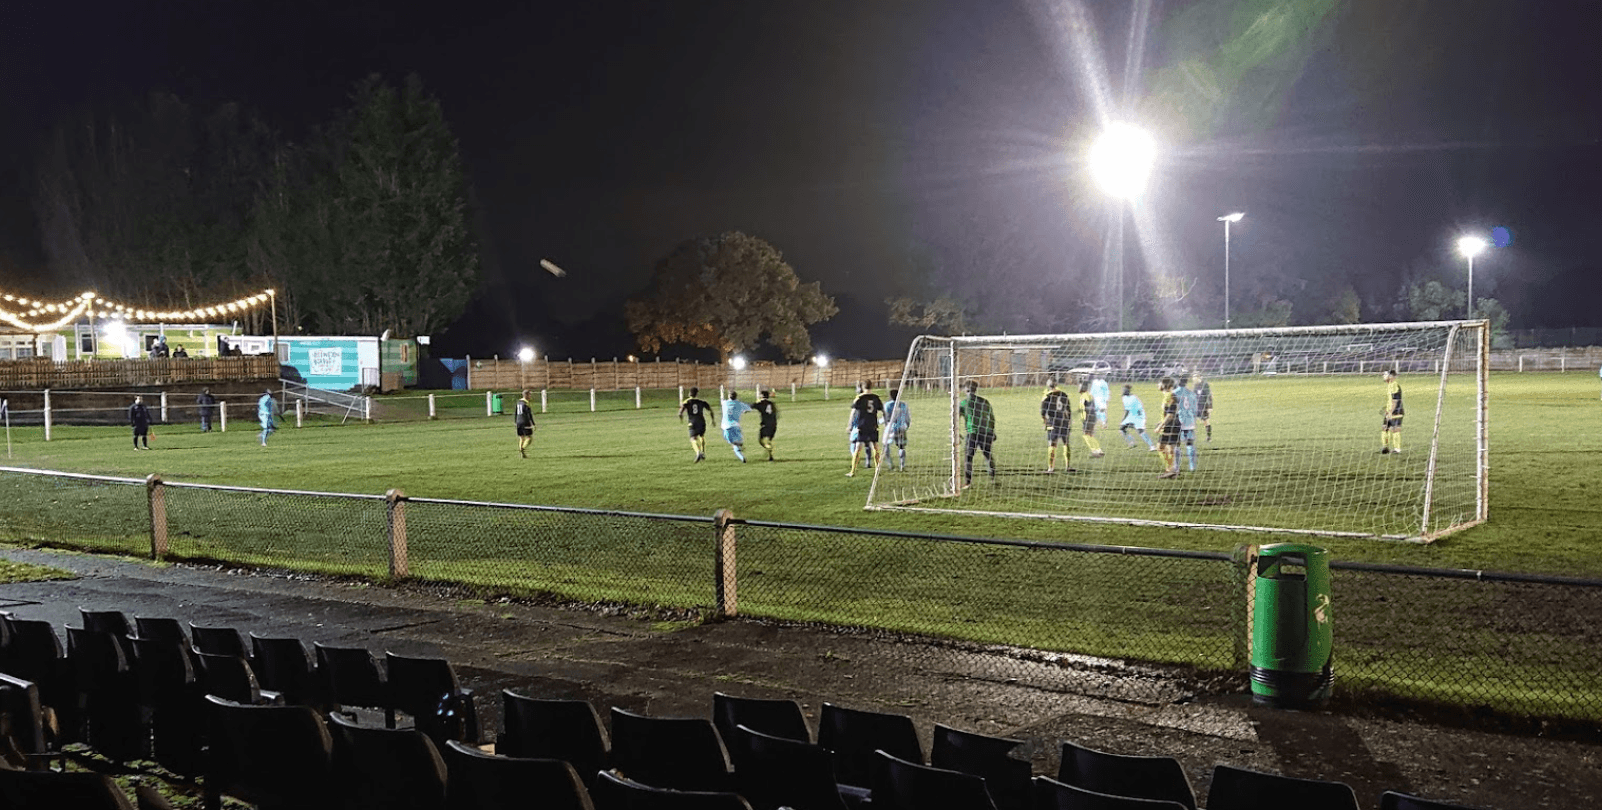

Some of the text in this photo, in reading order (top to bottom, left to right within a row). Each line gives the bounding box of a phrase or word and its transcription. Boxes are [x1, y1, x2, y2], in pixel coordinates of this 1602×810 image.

[692, 403, 698, 414] 8
[867, 400, 874, 413] 5
[1056, 396, 1063, 410] 6
[516, 404, 523, 415] 11
[765, 404, 772, 414] 4
